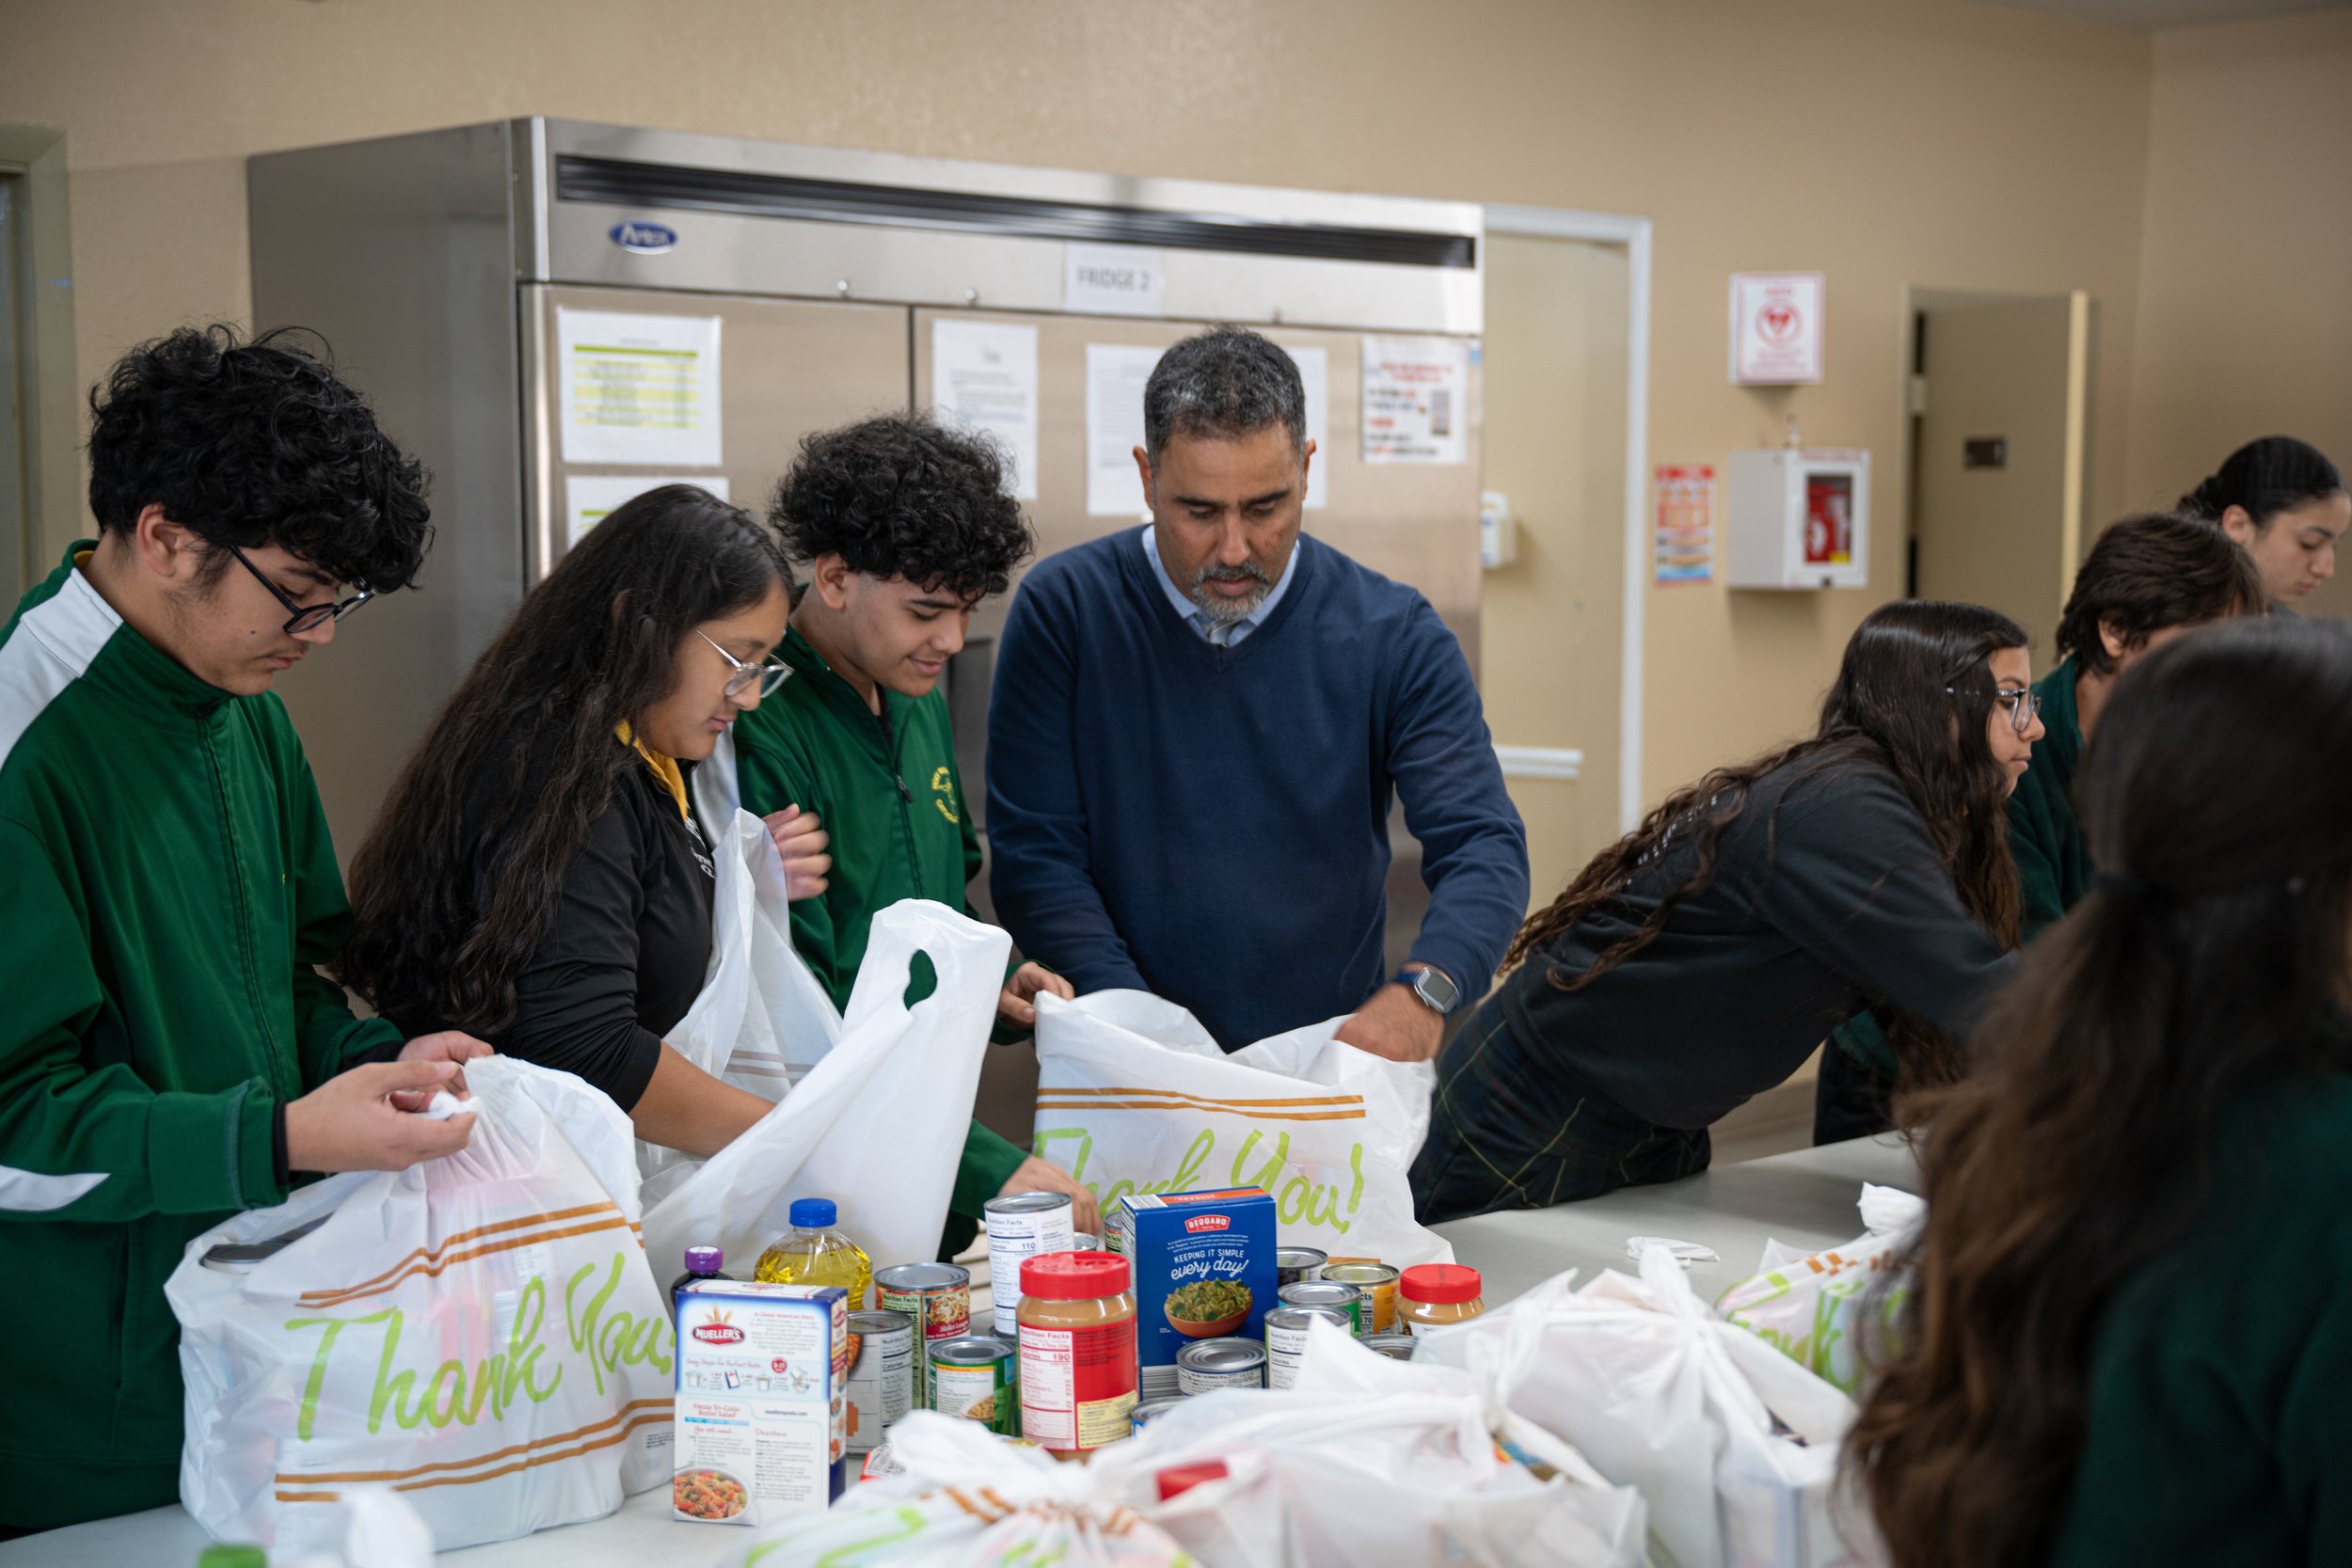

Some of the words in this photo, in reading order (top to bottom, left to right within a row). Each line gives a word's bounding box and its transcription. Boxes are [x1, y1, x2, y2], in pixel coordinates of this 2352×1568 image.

[1076, 265, 1135, 292] FRIDGE
[1140, 269, 1151, 293] 2
[1033, 1128, 1216, 1220] Thak
[1231, 1129, 1364, 1234] You!
[1188, 1217, 1227, 1228] REGGANO
[1022, 1242, 1036, 1250] 110
[1173, 1250, 1206, 1263] KEEPING
[1208, 1249, 1216, 1258] IT
[1217, 1248, 1245, 1259] SIMPLE
[1170, 1259, 1211, 1280] every
[1213, 1256, 1249, 1278] day!
[694, 1327, 741, 1340] MUELLER'S
[285, 1275, 563, 1442] Thank
[1053, 1353, 1071, 1361] 190
